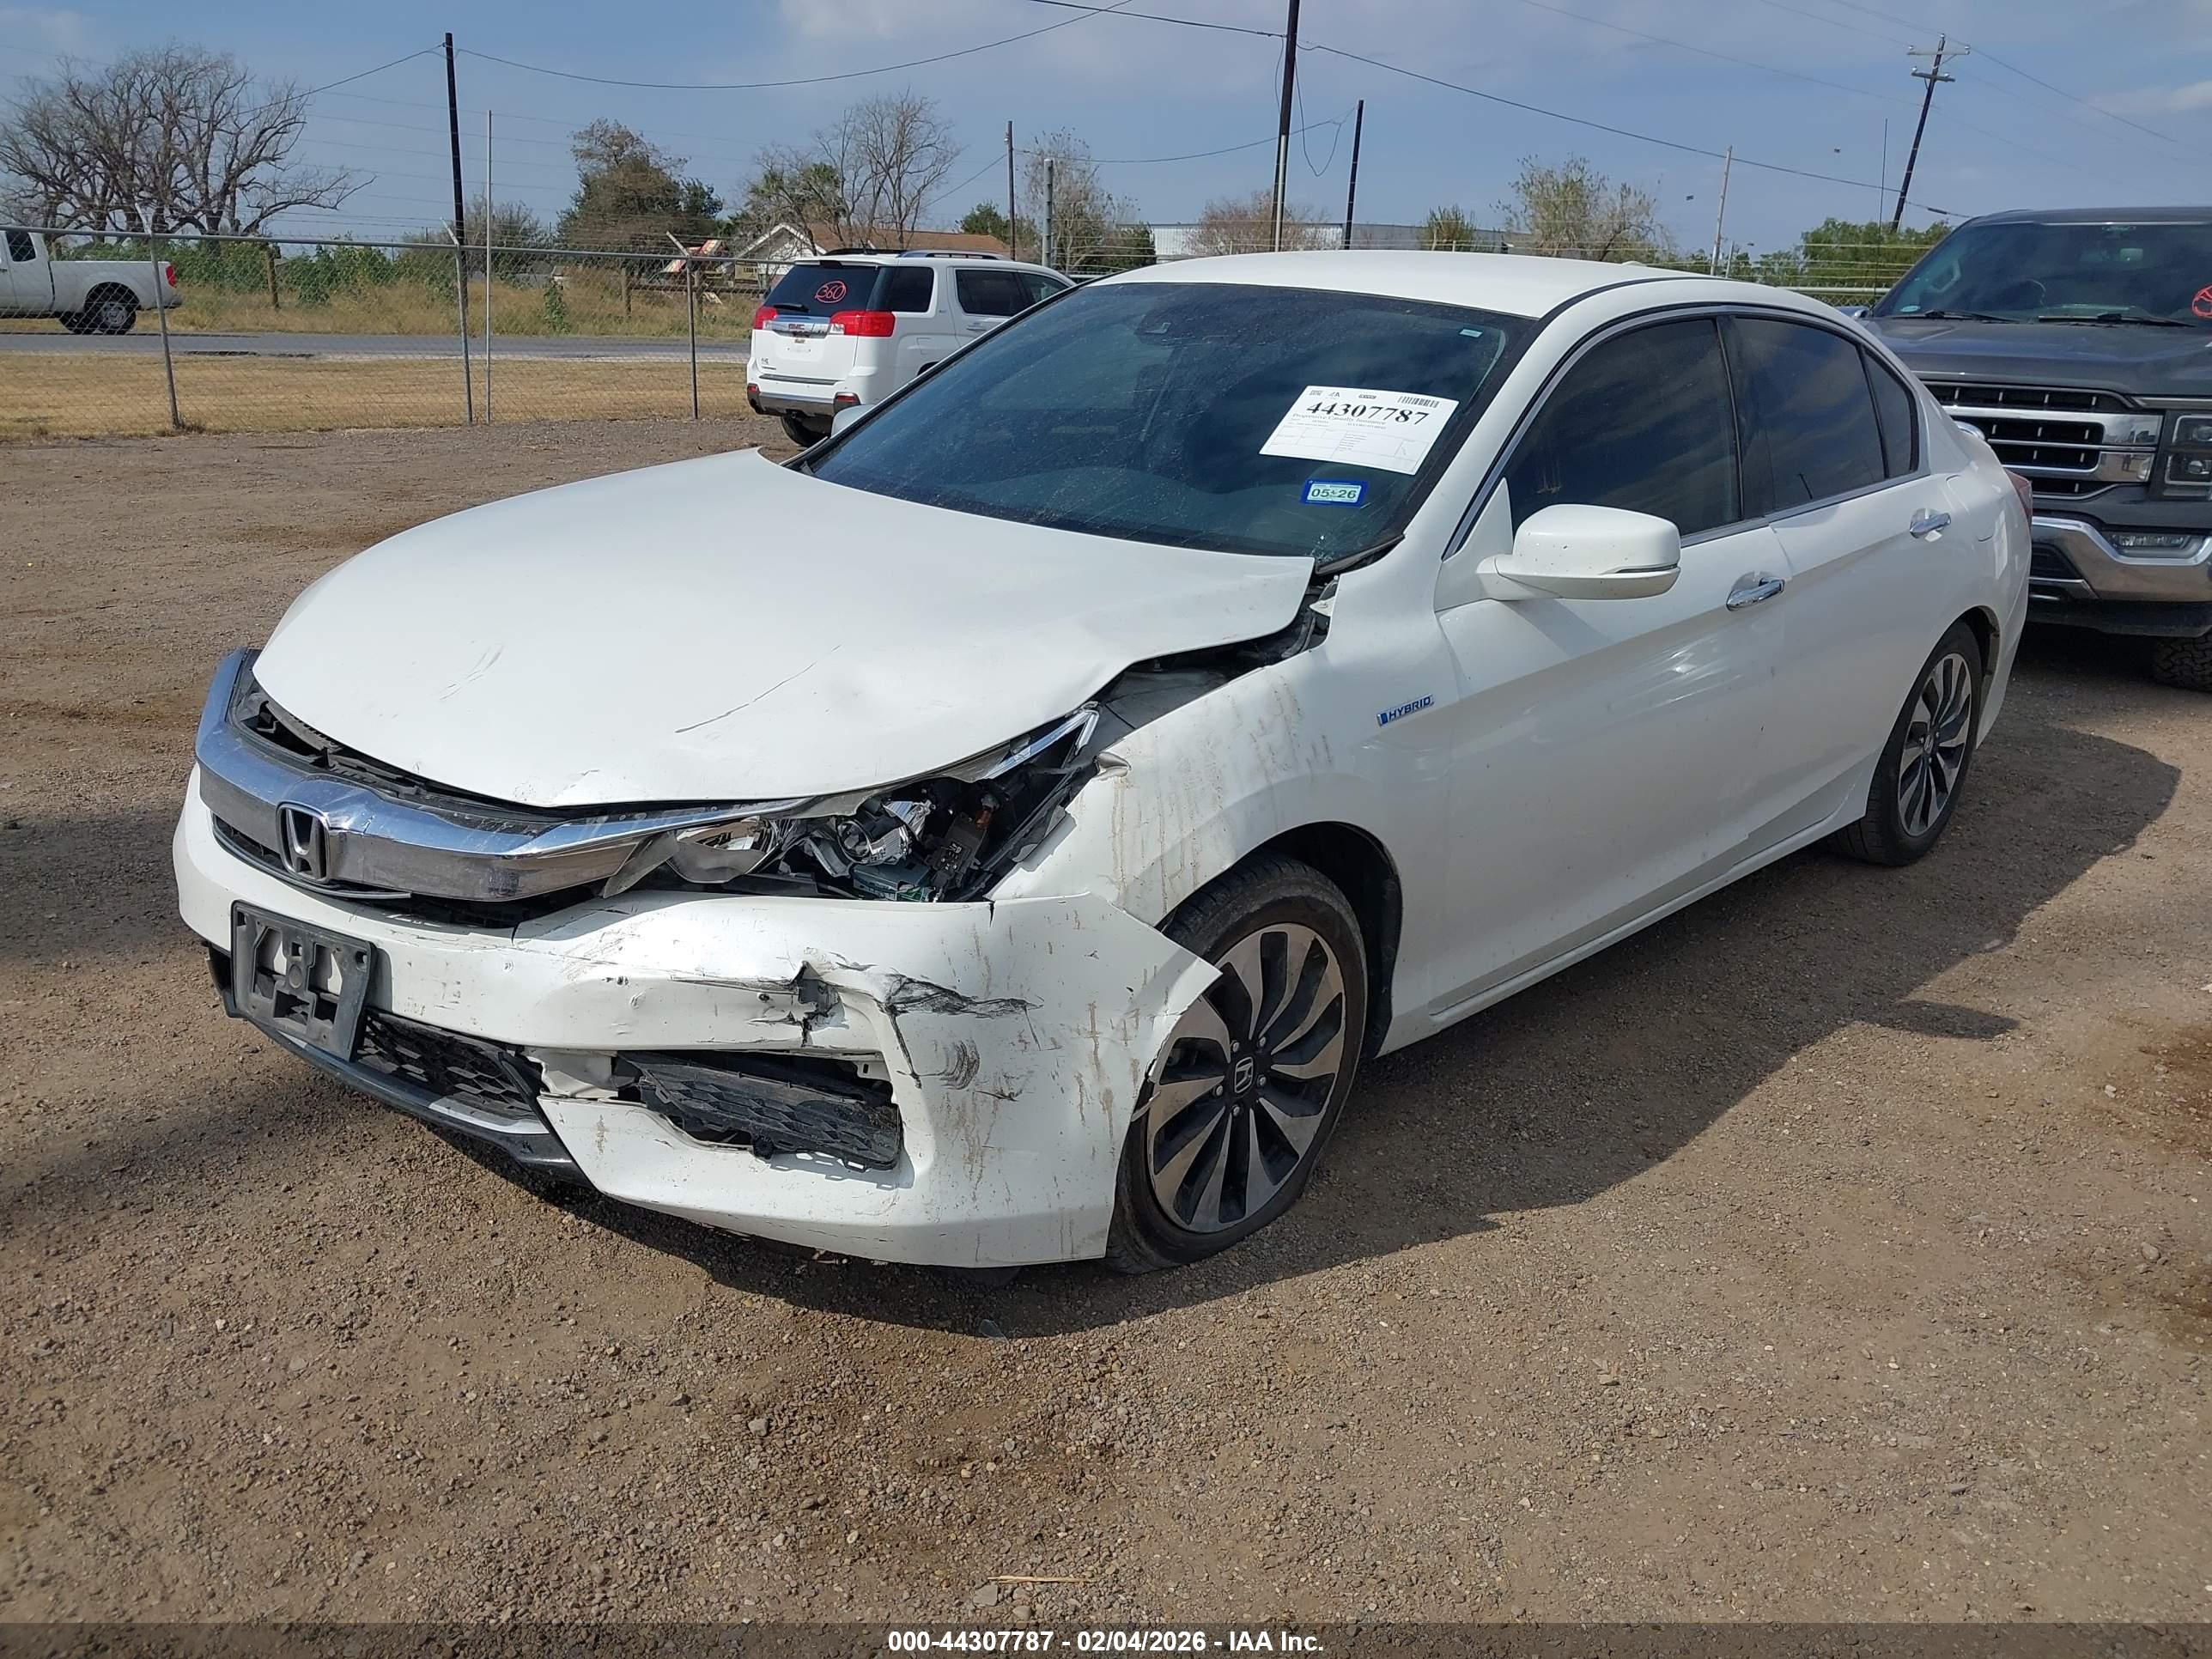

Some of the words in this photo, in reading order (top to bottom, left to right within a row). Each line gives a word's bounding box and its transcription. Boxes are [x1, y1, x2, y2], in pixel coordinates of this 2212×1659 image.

[816, 283, 845, 301] 360
[1306, 401, 1430, 425] 44307787
[1311, 488, 1330, 497] 05
[1337, 489, 1357, 499] 26
[1388, 696, 1431, 721] HYBRID
